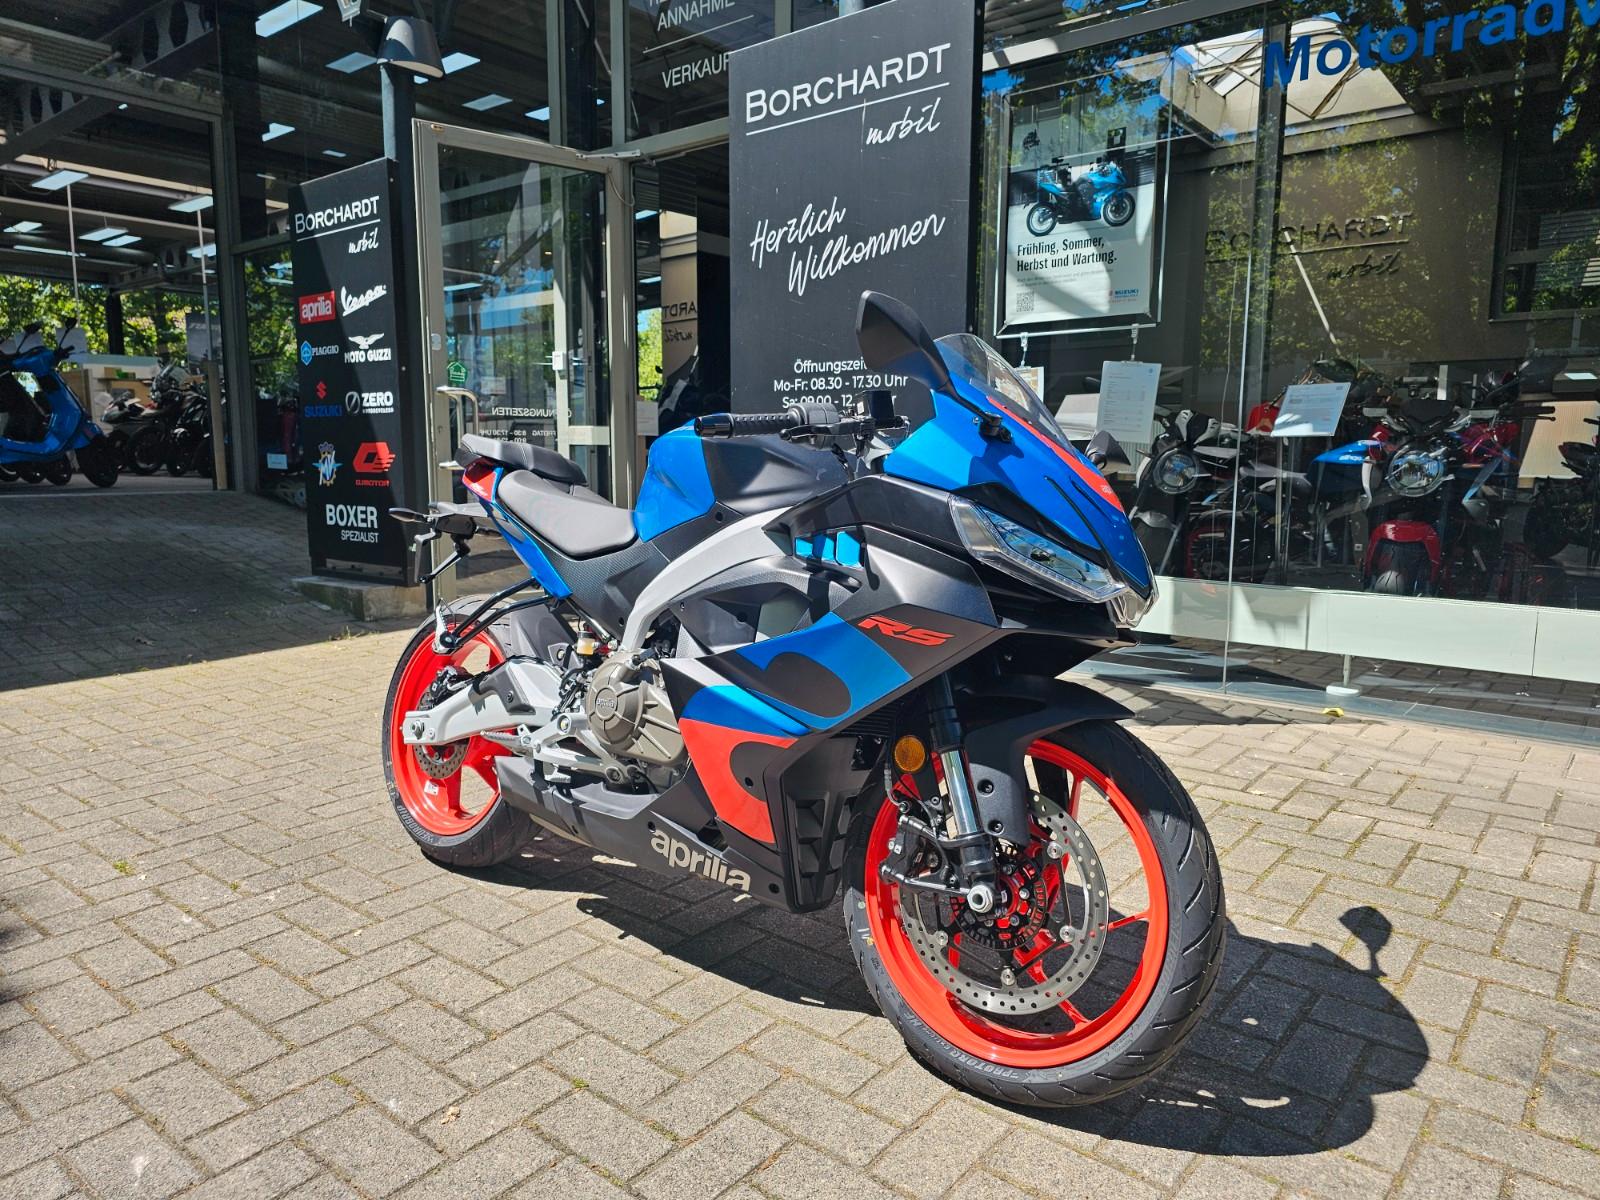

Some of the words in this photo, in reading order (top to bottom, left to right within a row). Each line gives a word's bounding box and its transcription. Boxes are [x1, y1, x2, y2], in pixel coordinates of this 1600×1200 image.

[746, 43, 951, 124] BORCHARDT
[865, 97, 942, 145] mobil
[295, 195, 380, 233] BORCHARDT
[348, 227, 379, 254] mobil
[750, 196, 847, 269] Herzlich
[1205, 210, 1412, 252] BOCHARDT
[788, 213, 946, 296] Willkommen
[1017, 242, 1059, 256] Frühling,
[1062, 237, 1105, 251] Sommer,
[1017, 257, 1048, 272] Herbst
[1051, 254, 1069, 268] und
[1072, 250, 1118, 266] Wartung.
[302, 297, 332, 320] aprilia
[340, 284, 387, 317] Vespa
[312, 344, 339, 356] PIAGGIO
[344, 349, 366, 364] MOTO
[367, 348, 392, 362] GUZZI
[793, 356, 868, 374] Öffnungszei
[810, 377, 842, 390] 08.30
[852, 374, 881, 388] 17.30
[884, 374, 909, 387] Uhr
[304, 404, 343, 418] SUZUKI
[361, 391, 394, 407] ZERO
[800, 395, 832, 404] 0900
[841, 394, 856, 407] 12.
[325, 503, 378, 529] BOXER
[340, 529, 380, 544] SPEZIALIST
[857, 614, 955, 647] RS
[649, 827, 752, 894] aprilia
